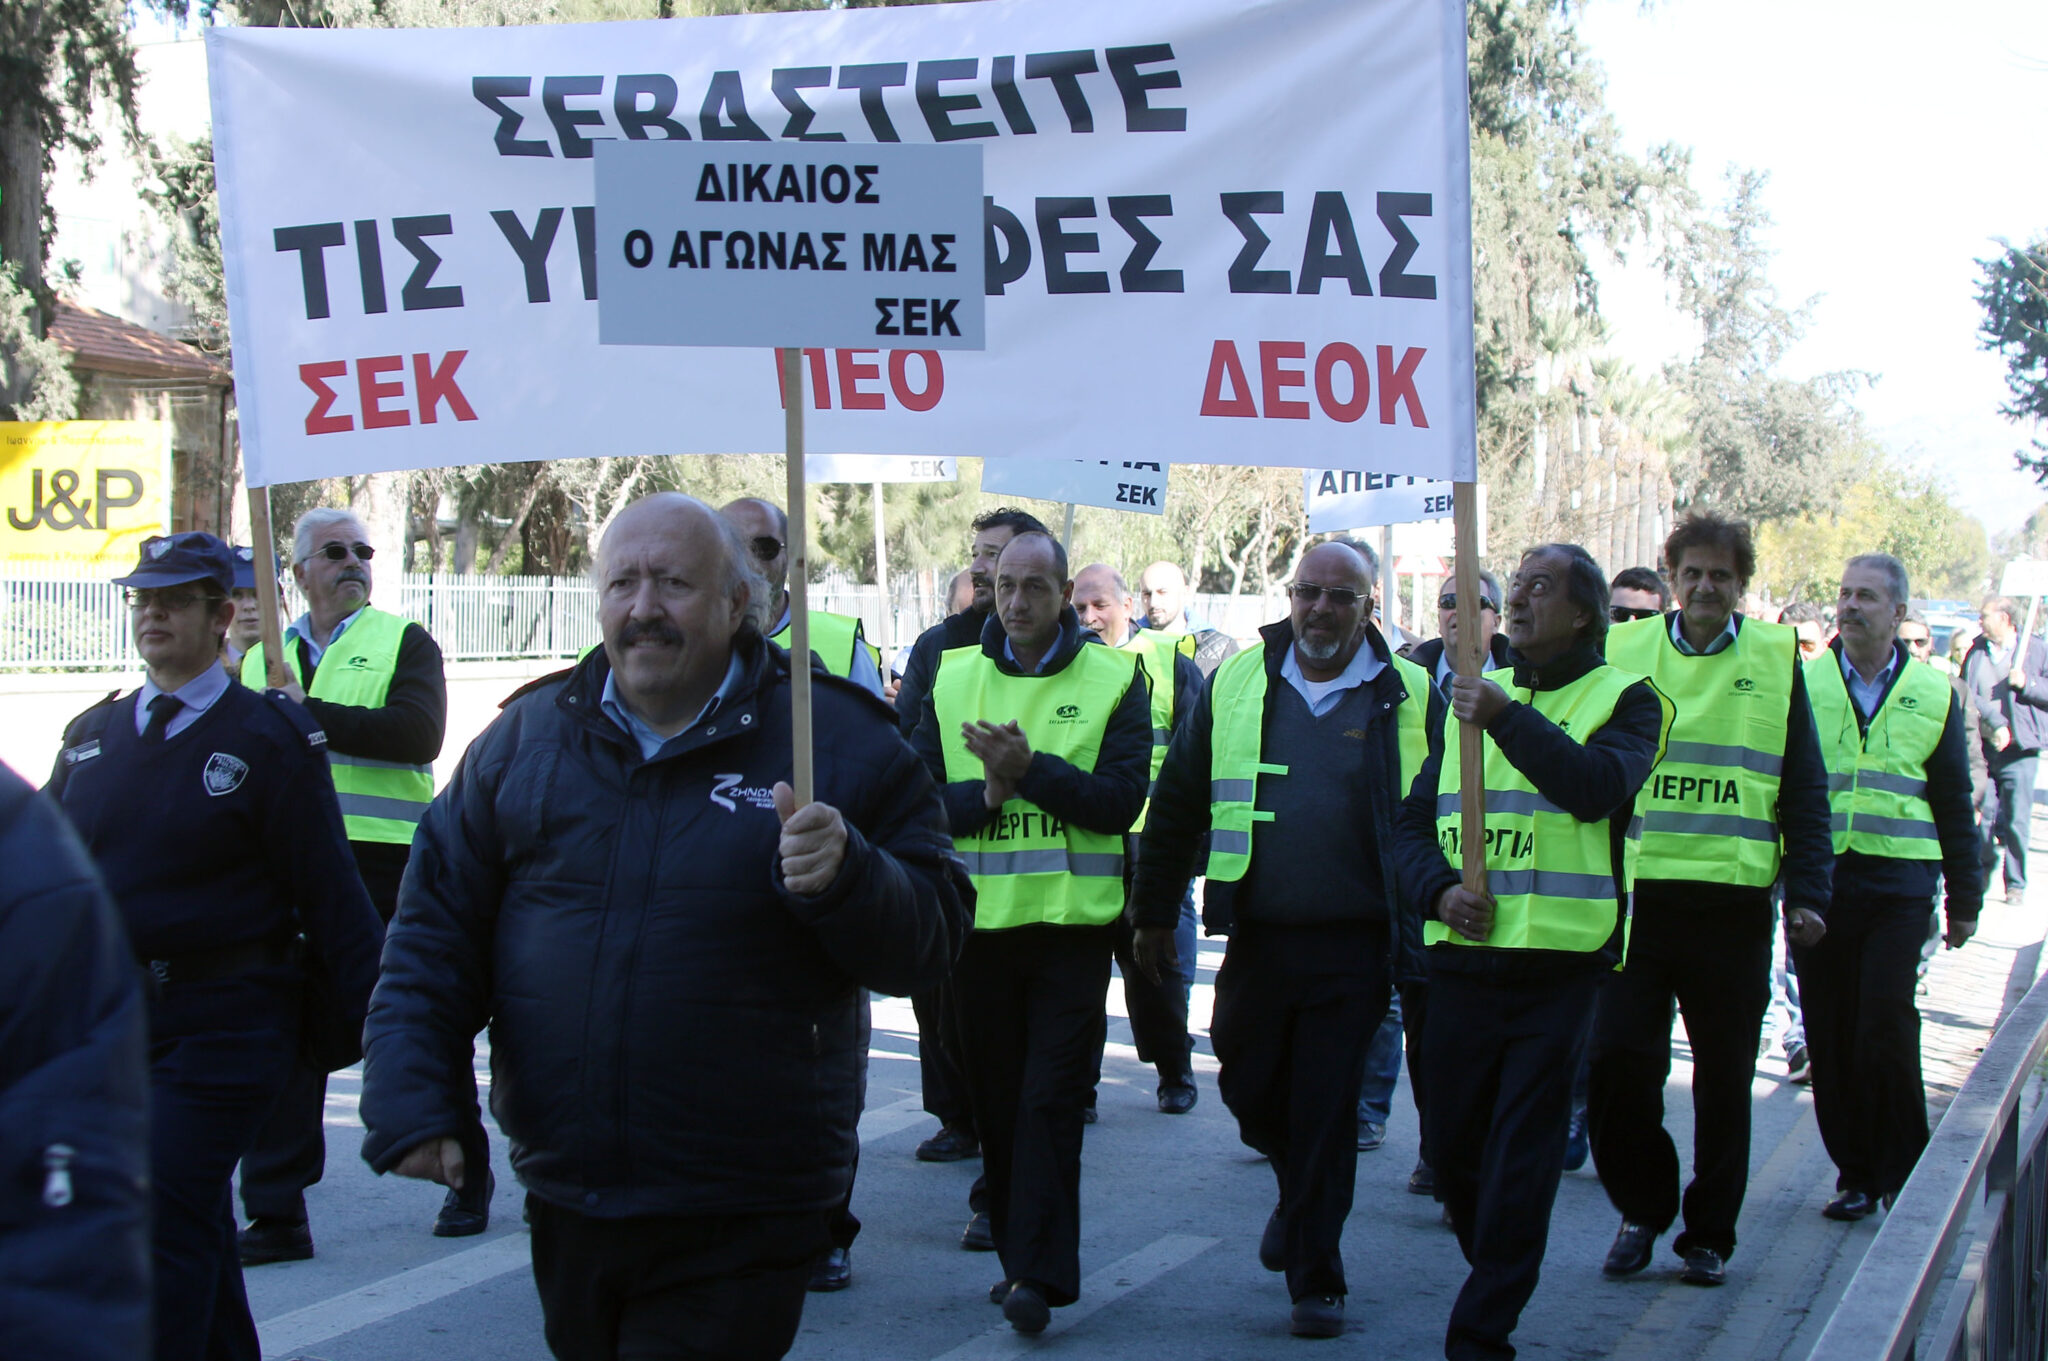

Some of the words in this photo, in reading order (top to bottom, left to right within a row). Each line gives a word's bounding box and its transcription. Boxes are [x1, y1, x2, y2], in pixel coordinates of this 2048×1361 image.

[472, 43, 1187, 158] ΣΕΒΑΣΤΕΙΤΕ
[695, 163, 880, 204] ΔΙΚΑΙΟΣ
[273, 214, 464, 319] ΤΙΣ
[1220, 191, 1437, 299] ΣΑΣ
[623, 229, 653, 268] Ο
[668, 230, 847, 271] ΑΓΩΝΑΣ
[863, 233, 957, 272] ΜΑΣ
[875, 298, 961, 336] ΣΕΚ
[298, 350, 479, 435] ΣΕΚ
[1200, 340, 1429, 428] ΔΕΟΚ
[910, 460, 945, 477] ΣΕΚ
[8, 468, 144, 531] J&P
[1116, 483, 1158, 506] ΣΕΚ
